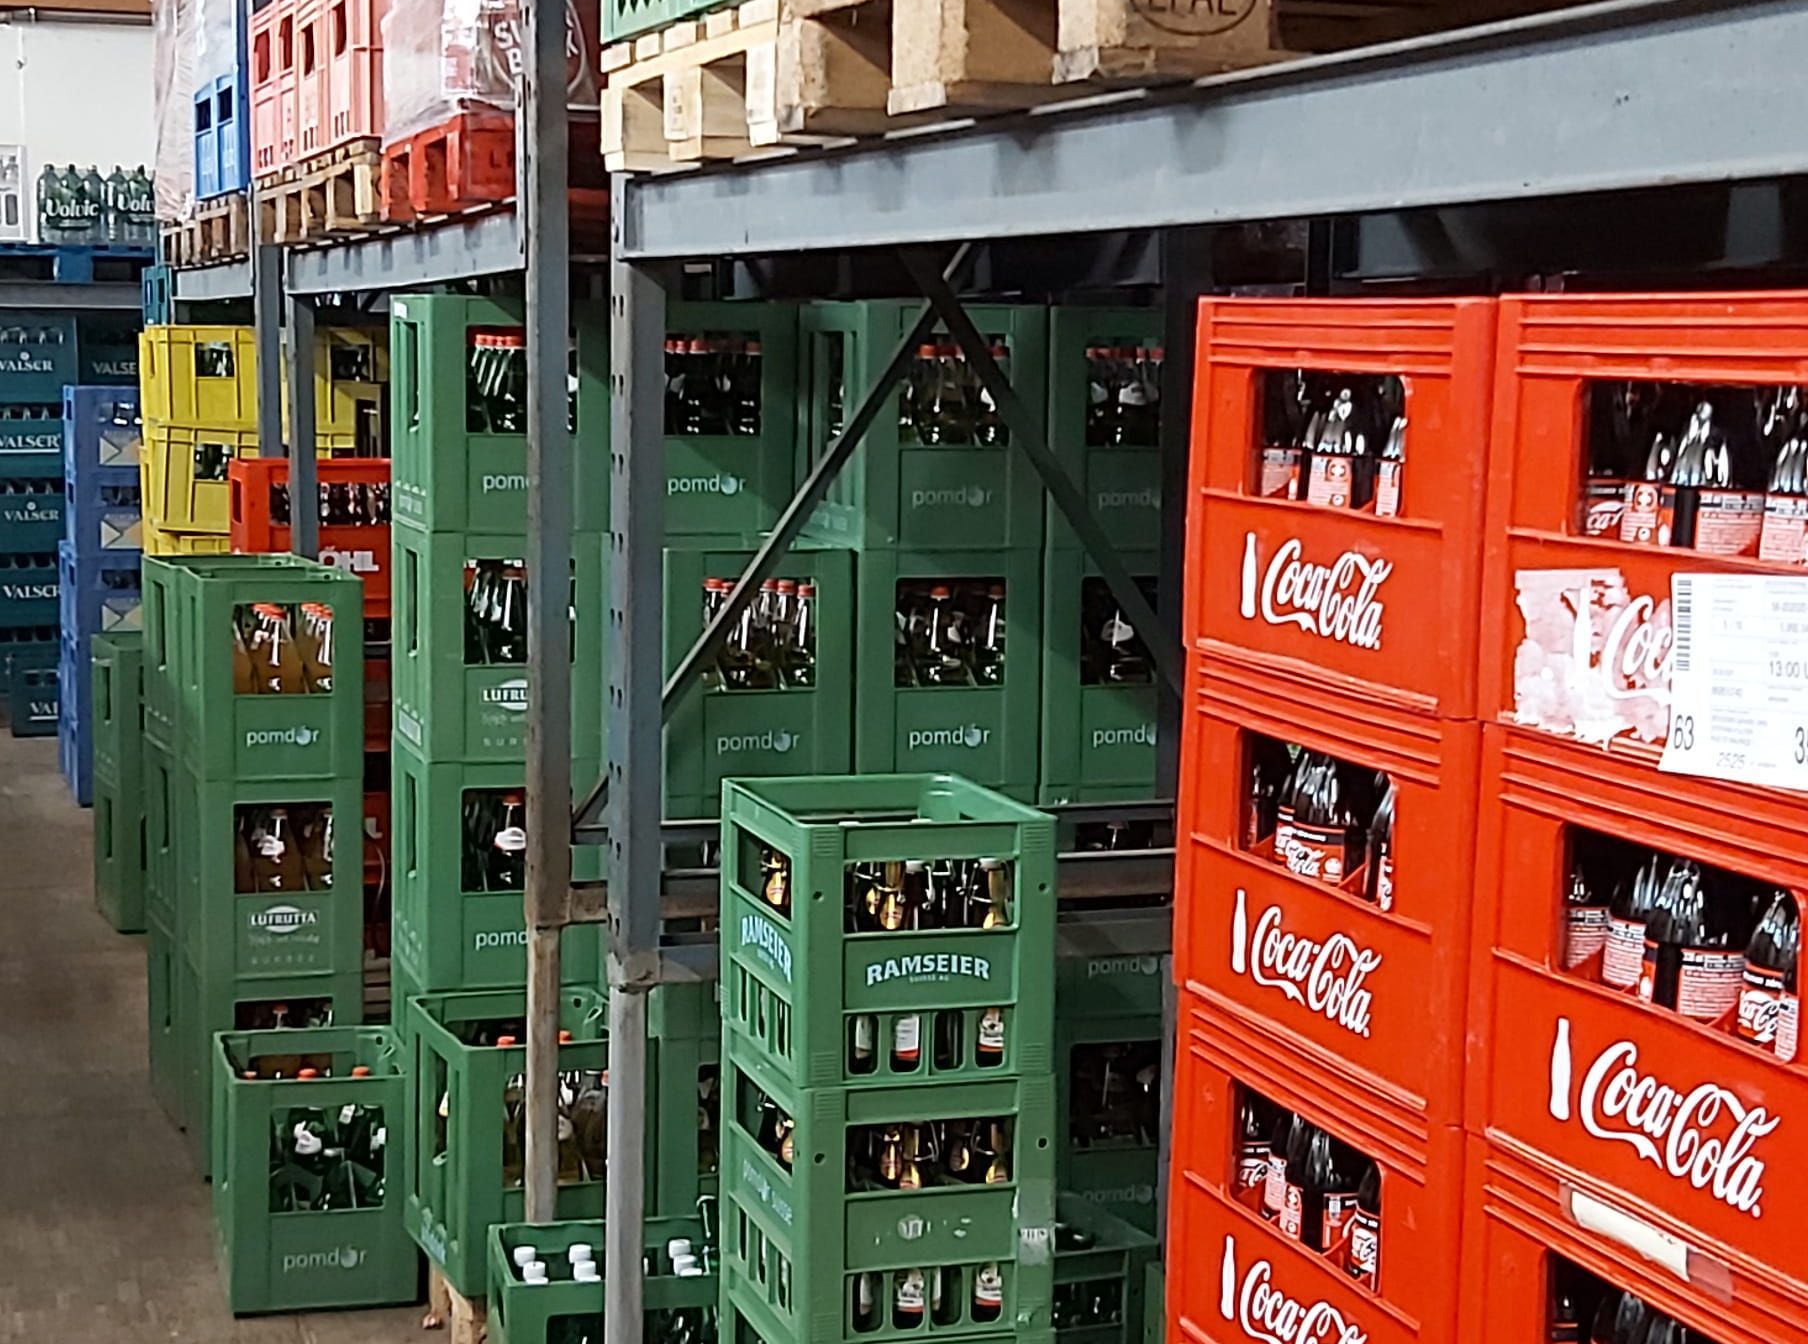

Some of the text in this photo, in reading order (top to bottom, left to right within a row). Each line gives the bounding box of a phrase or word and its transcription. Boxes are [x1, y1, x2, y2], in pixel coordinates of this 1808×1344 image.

[1261, 538, 1394, 650] Coca-Cola
[1673, 714, 1695, 751] 63
[740, 913, 793, 985] RAMSEIER
[865, 953, 991, 987] RAMSEIER
[1251, 905, 1382, 1038] Coca-Cola
[1580, 1041, 1780, 1218] Coca-Cola
